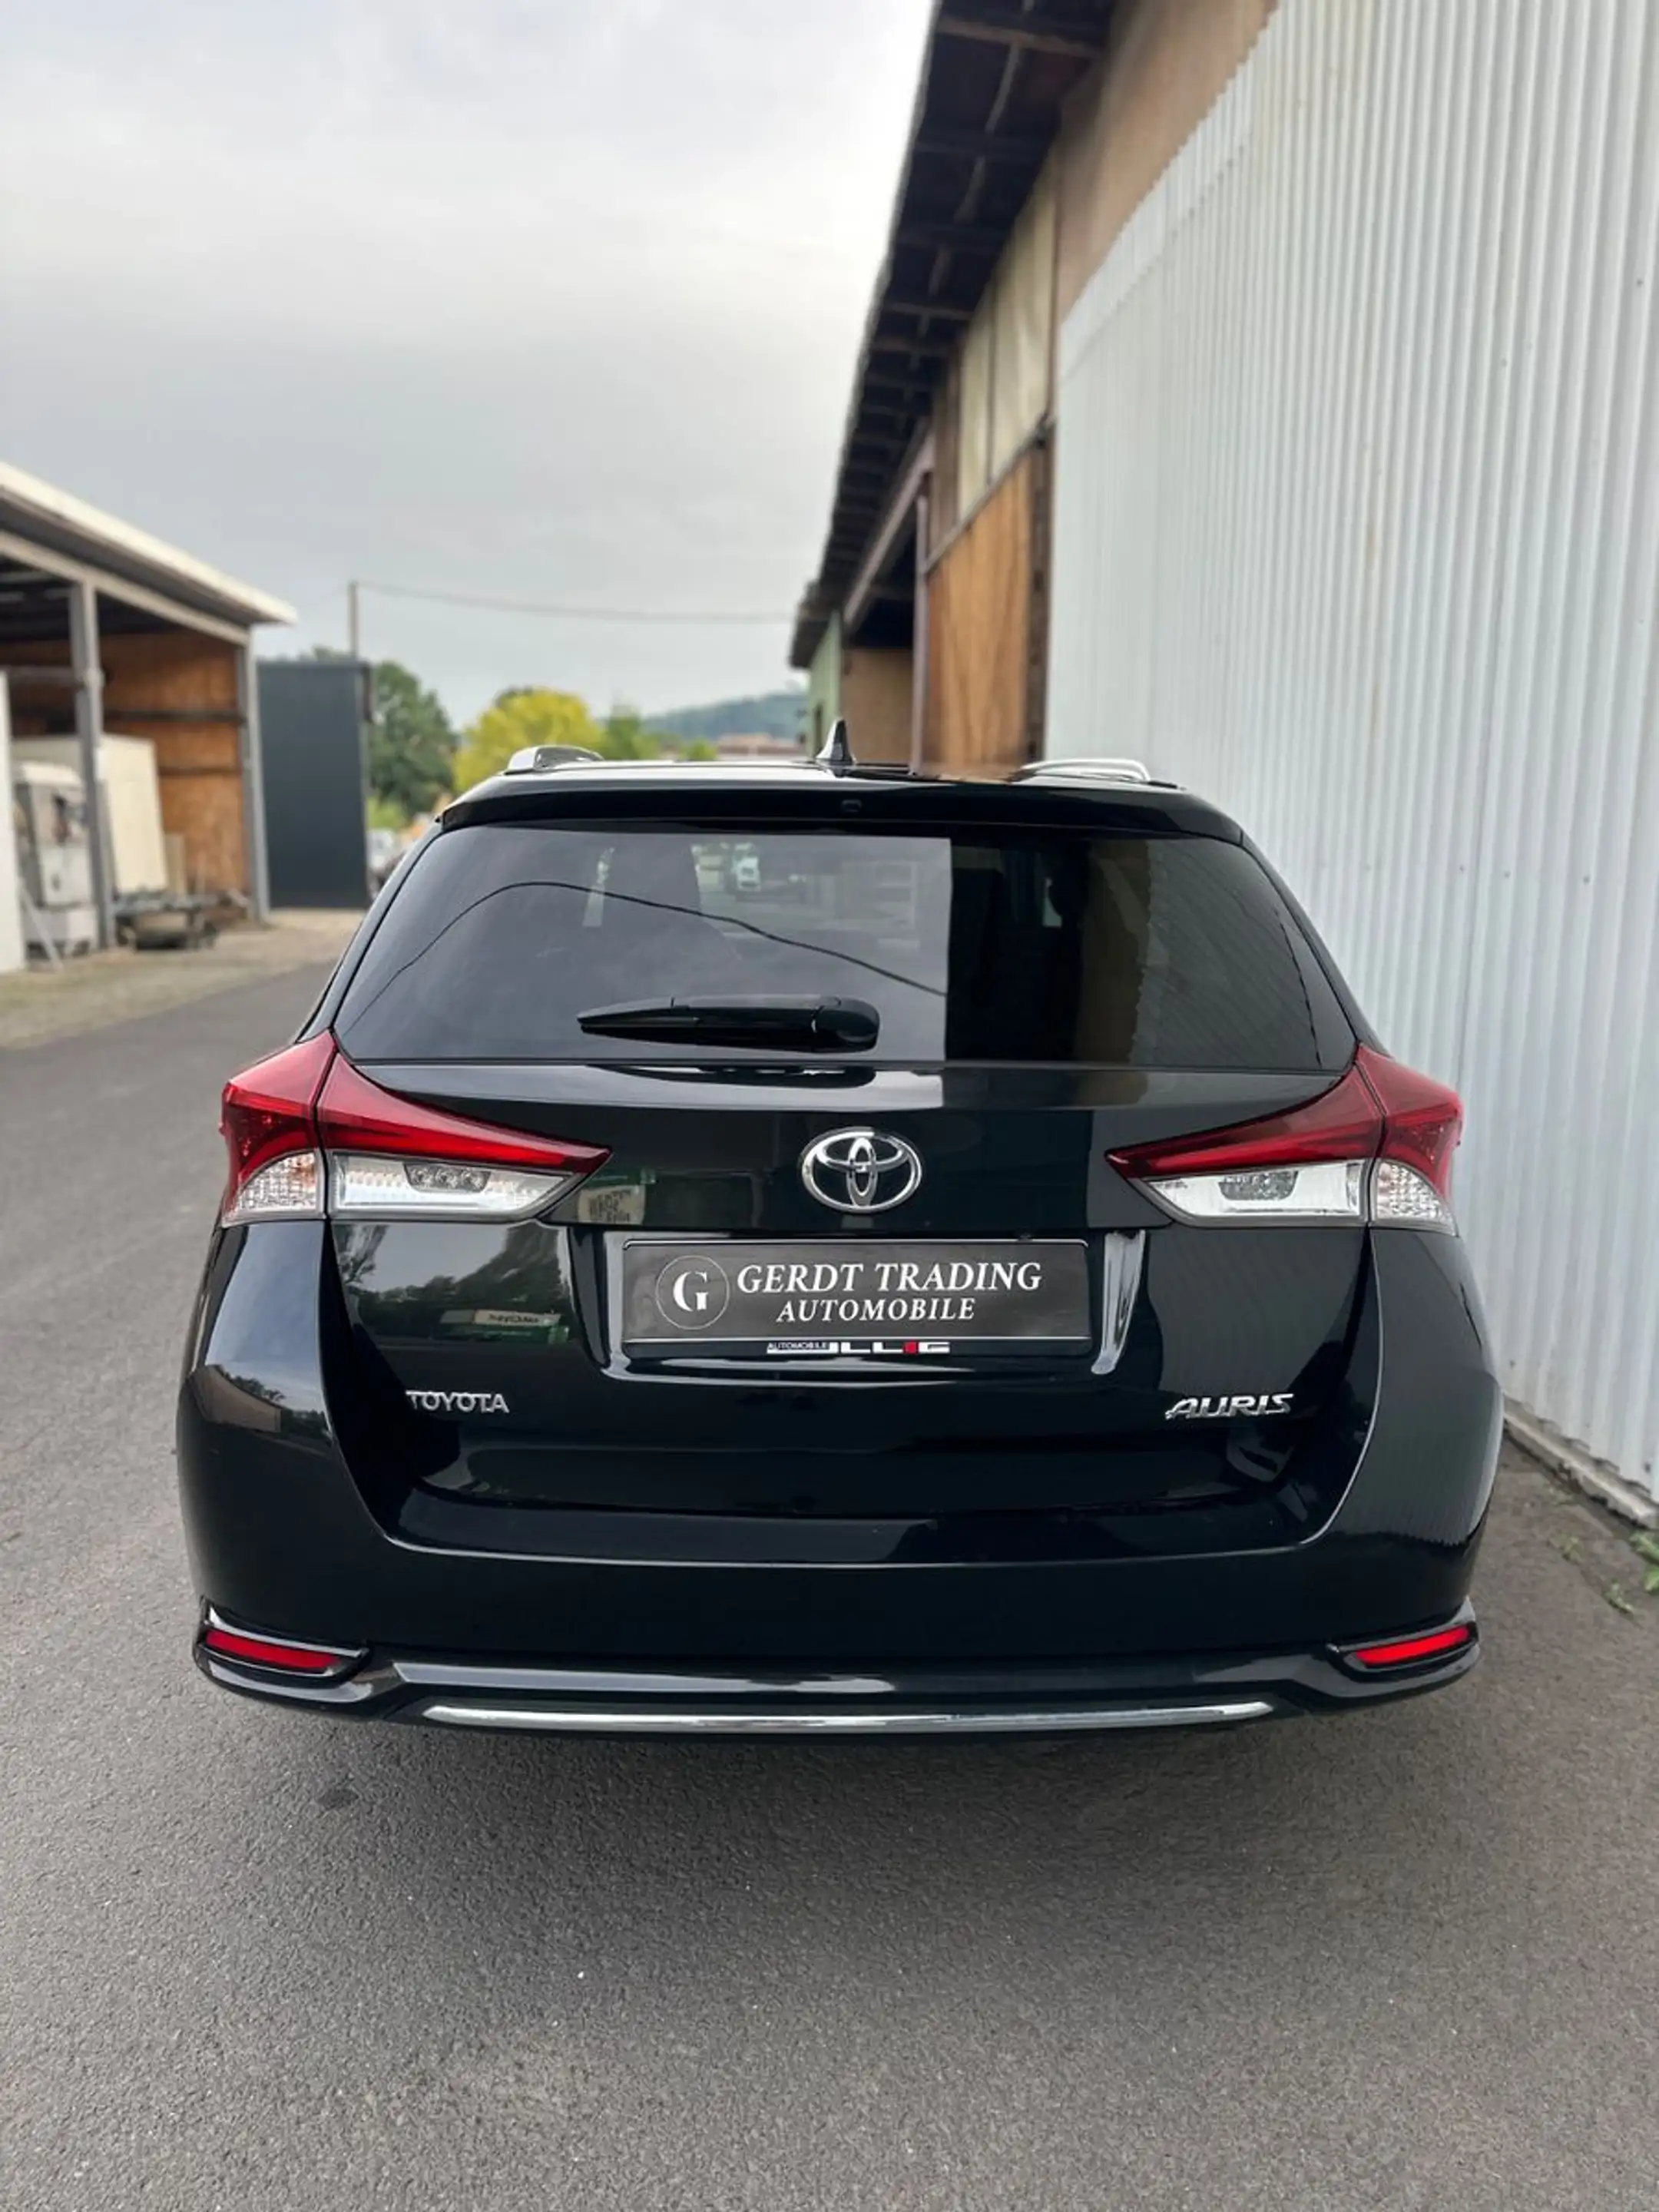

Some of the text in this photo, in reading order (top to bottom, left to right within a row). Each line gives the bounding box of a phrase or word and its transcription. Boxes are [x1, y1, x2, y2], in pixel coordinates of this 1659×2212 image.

[673, 1270, 709, 1311] G
[737, 1262, 1042, 1293] GERDT TRADING
[776, 1297, 975, 1323] AUTOMOBILE
[767, 1342, 827, 1350] AUTOMOBILE
[406, 1389, 510, 1414] TOYOTA
[1165, 1393, 1294, 1419] AURIS
